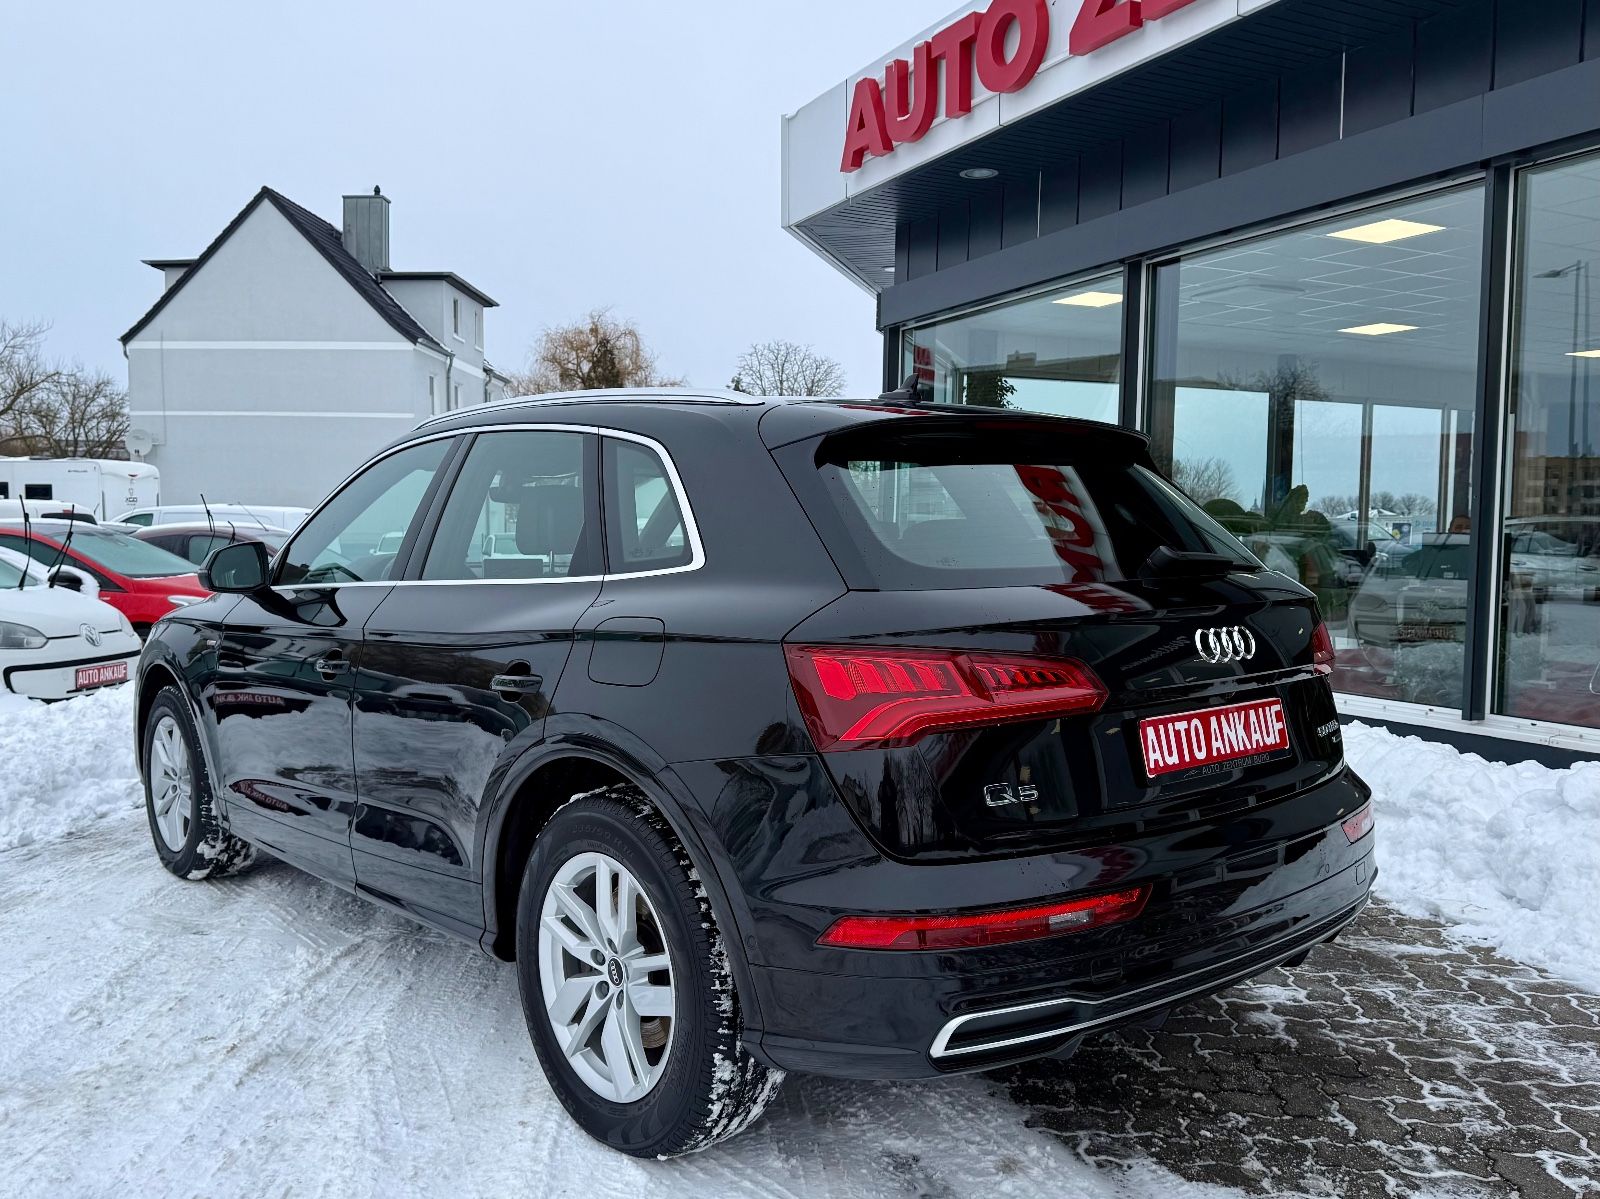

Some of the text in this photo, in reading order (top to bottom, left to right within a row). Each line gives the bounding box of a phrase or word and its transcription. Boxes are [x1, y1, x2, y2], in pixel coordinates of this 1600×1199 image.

[840, 0, 1049, 173] AUTO
[78, 664, 127, 685] AUTO ANKAUF
[1146, 704, 1284, 769] AUTO ANKAUF
[1202, 763, 1220, 775] AUTO
[983, 782, 1039, 807] Q5
